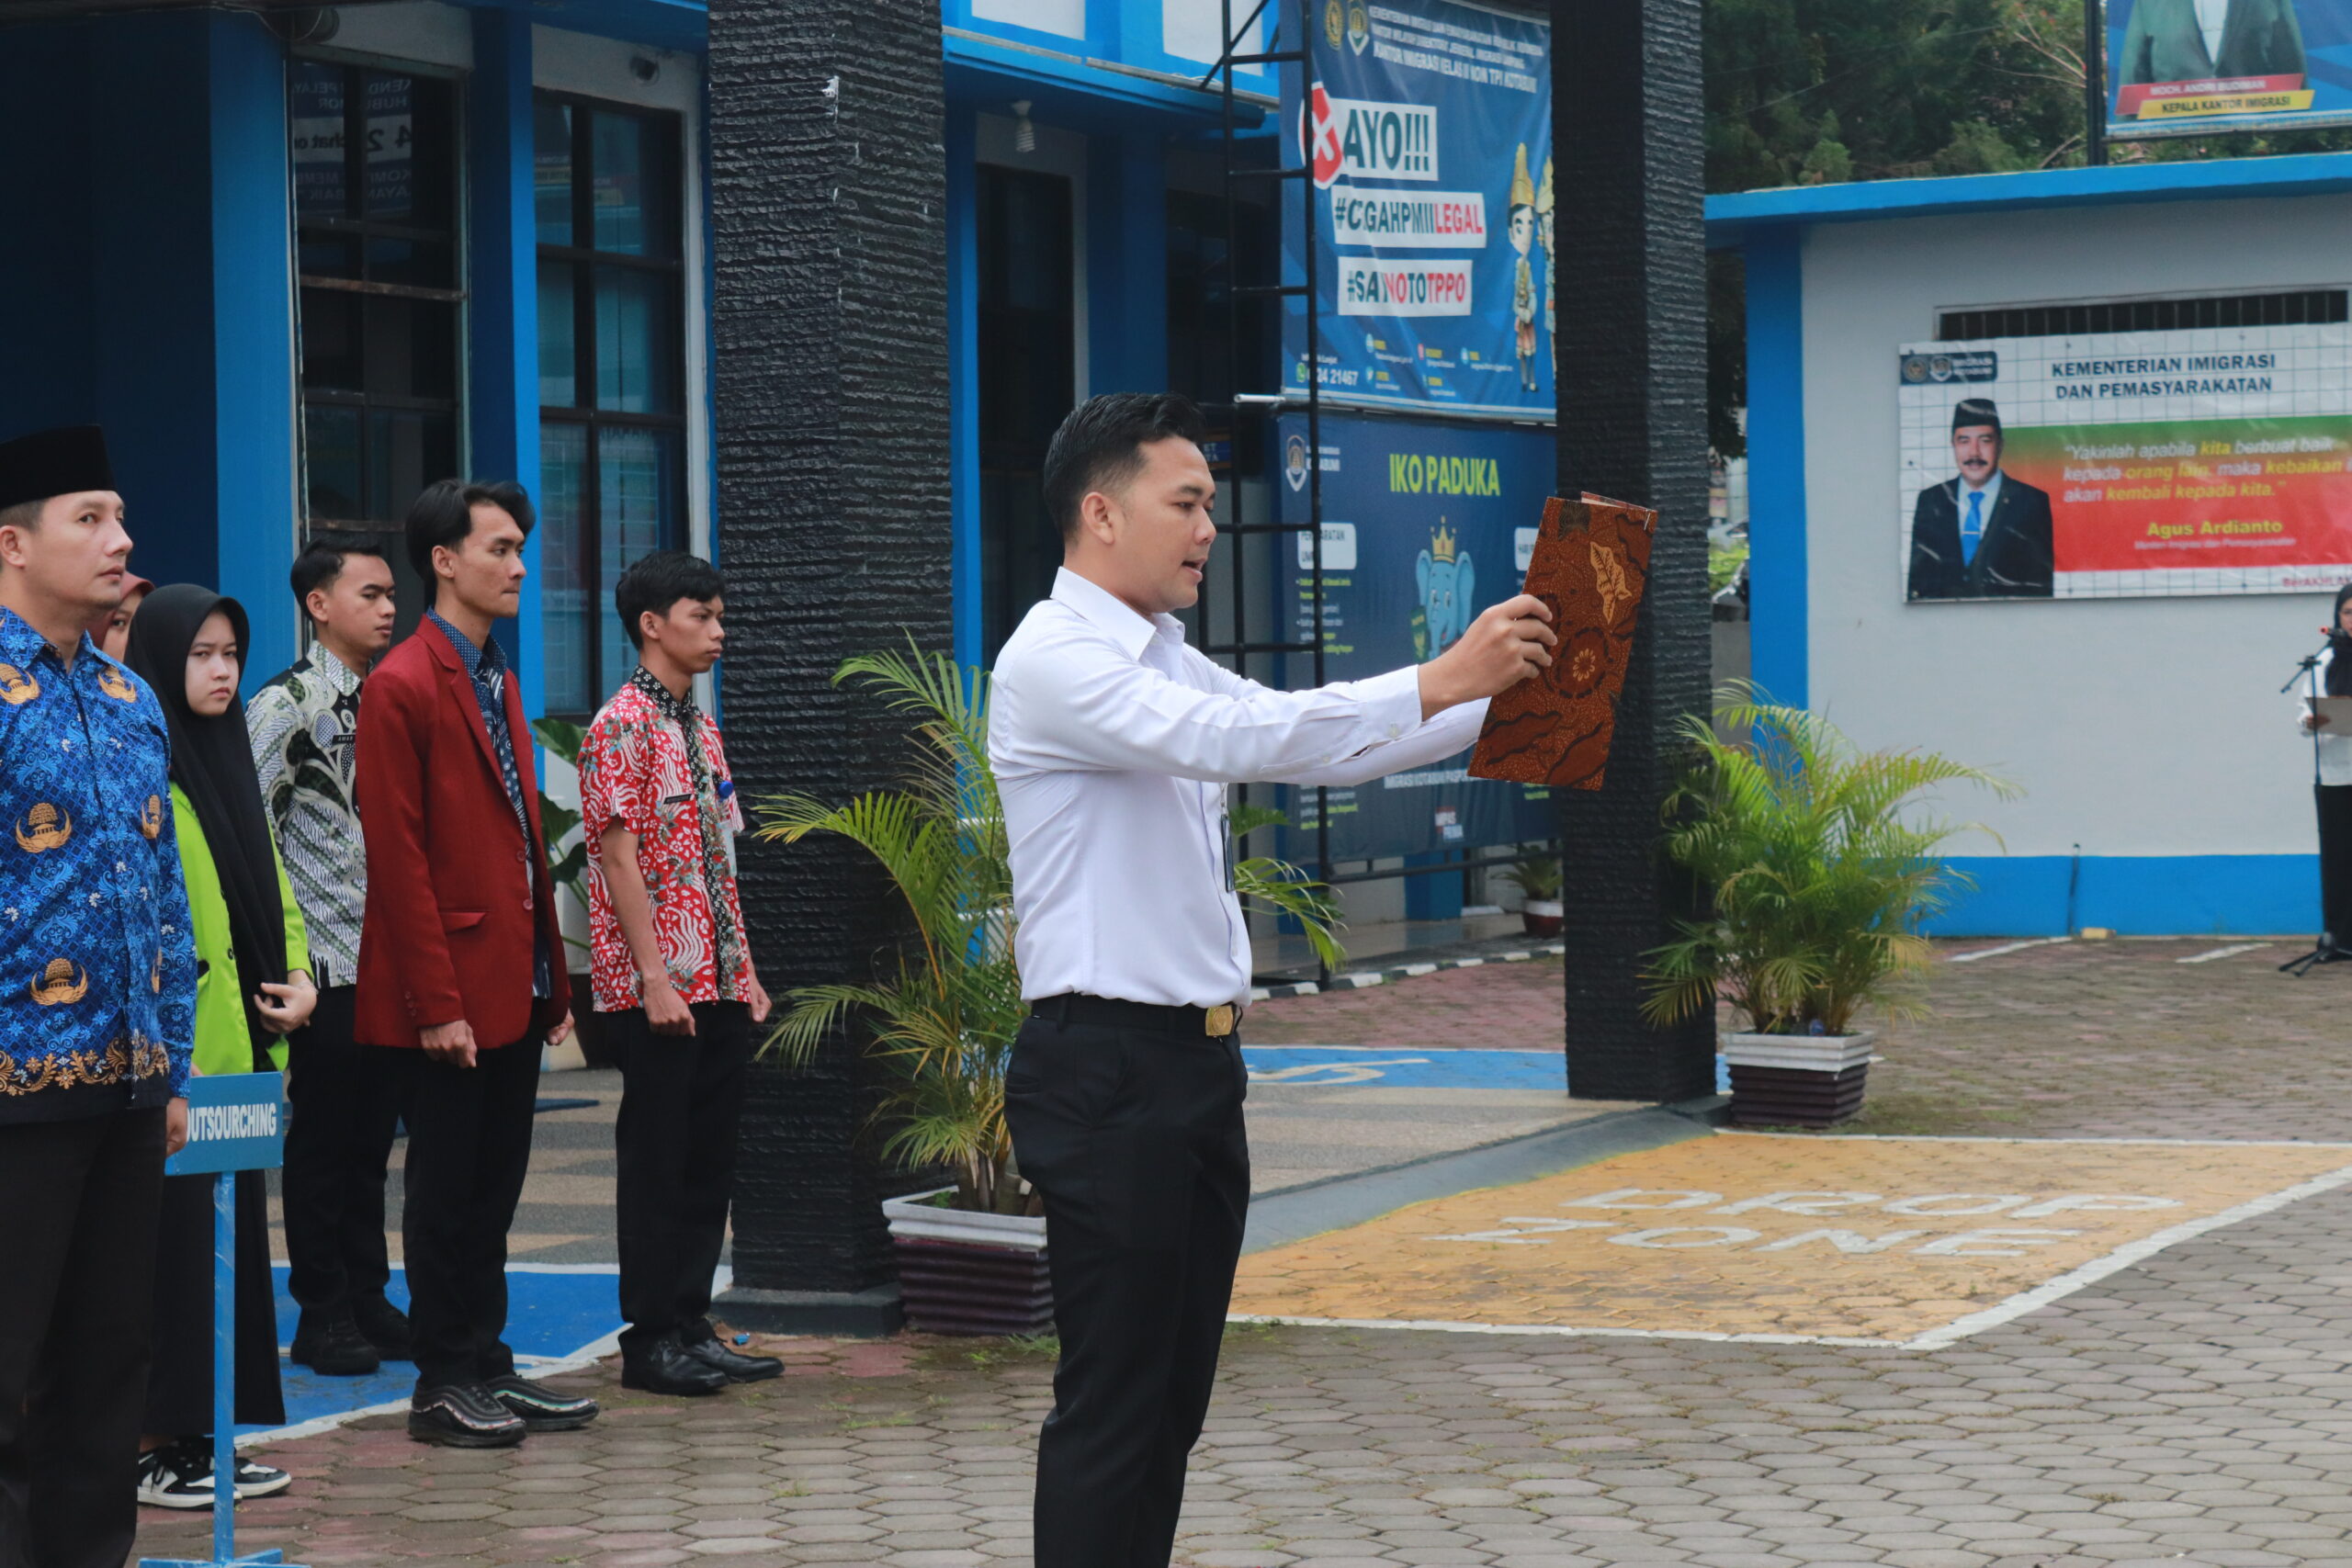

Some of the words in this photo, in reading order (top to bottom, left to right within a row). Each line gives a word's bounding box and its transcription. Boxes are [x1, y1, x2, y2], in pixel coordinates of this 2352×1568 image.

[2162, 102, 2199, 114] KEPALA
[2201, 99, 2243, 110] KANTOR
[2245, 96, 2292, 107] IMIGRASI
[1343, 108, 1430, 172] AYO!!!
[2052, 358, 2182, 378] KEMENTERIAN
[2188, 354, 2276, 371] IMIGRASI
[2056, 384, 2093, 400] DAN
[2099, 377, 2272, 397] PEMASYARAKATAN
[2139, 441, 2197, 461] apabila
[2199, 440, 2232, 456] kita
[2234, 438, 2297, 455] berbuat
[1389, 453, 1423, 493] IKO
[1426, 456, 1500, 496] PADUKA
[2064, 466, 2122, 484] kepada
[2125, 466, 2175, 481] orang
[2217, 460, 2263, 477] maka
[2265, 457, 2343, 475] kebaikan
[2064, 487, 2104, 503] akan
[2106, 483, 2172, 501] kembali
[2175, 480, 2237, 502] kepada
[2146, 522, 2195, 540] Agus
[2199, 519, 2283, 535] Ardianto
[1558, 1188, 2185, 1218] DROP
[1420, 1216, 2084, 1256] ZONE
